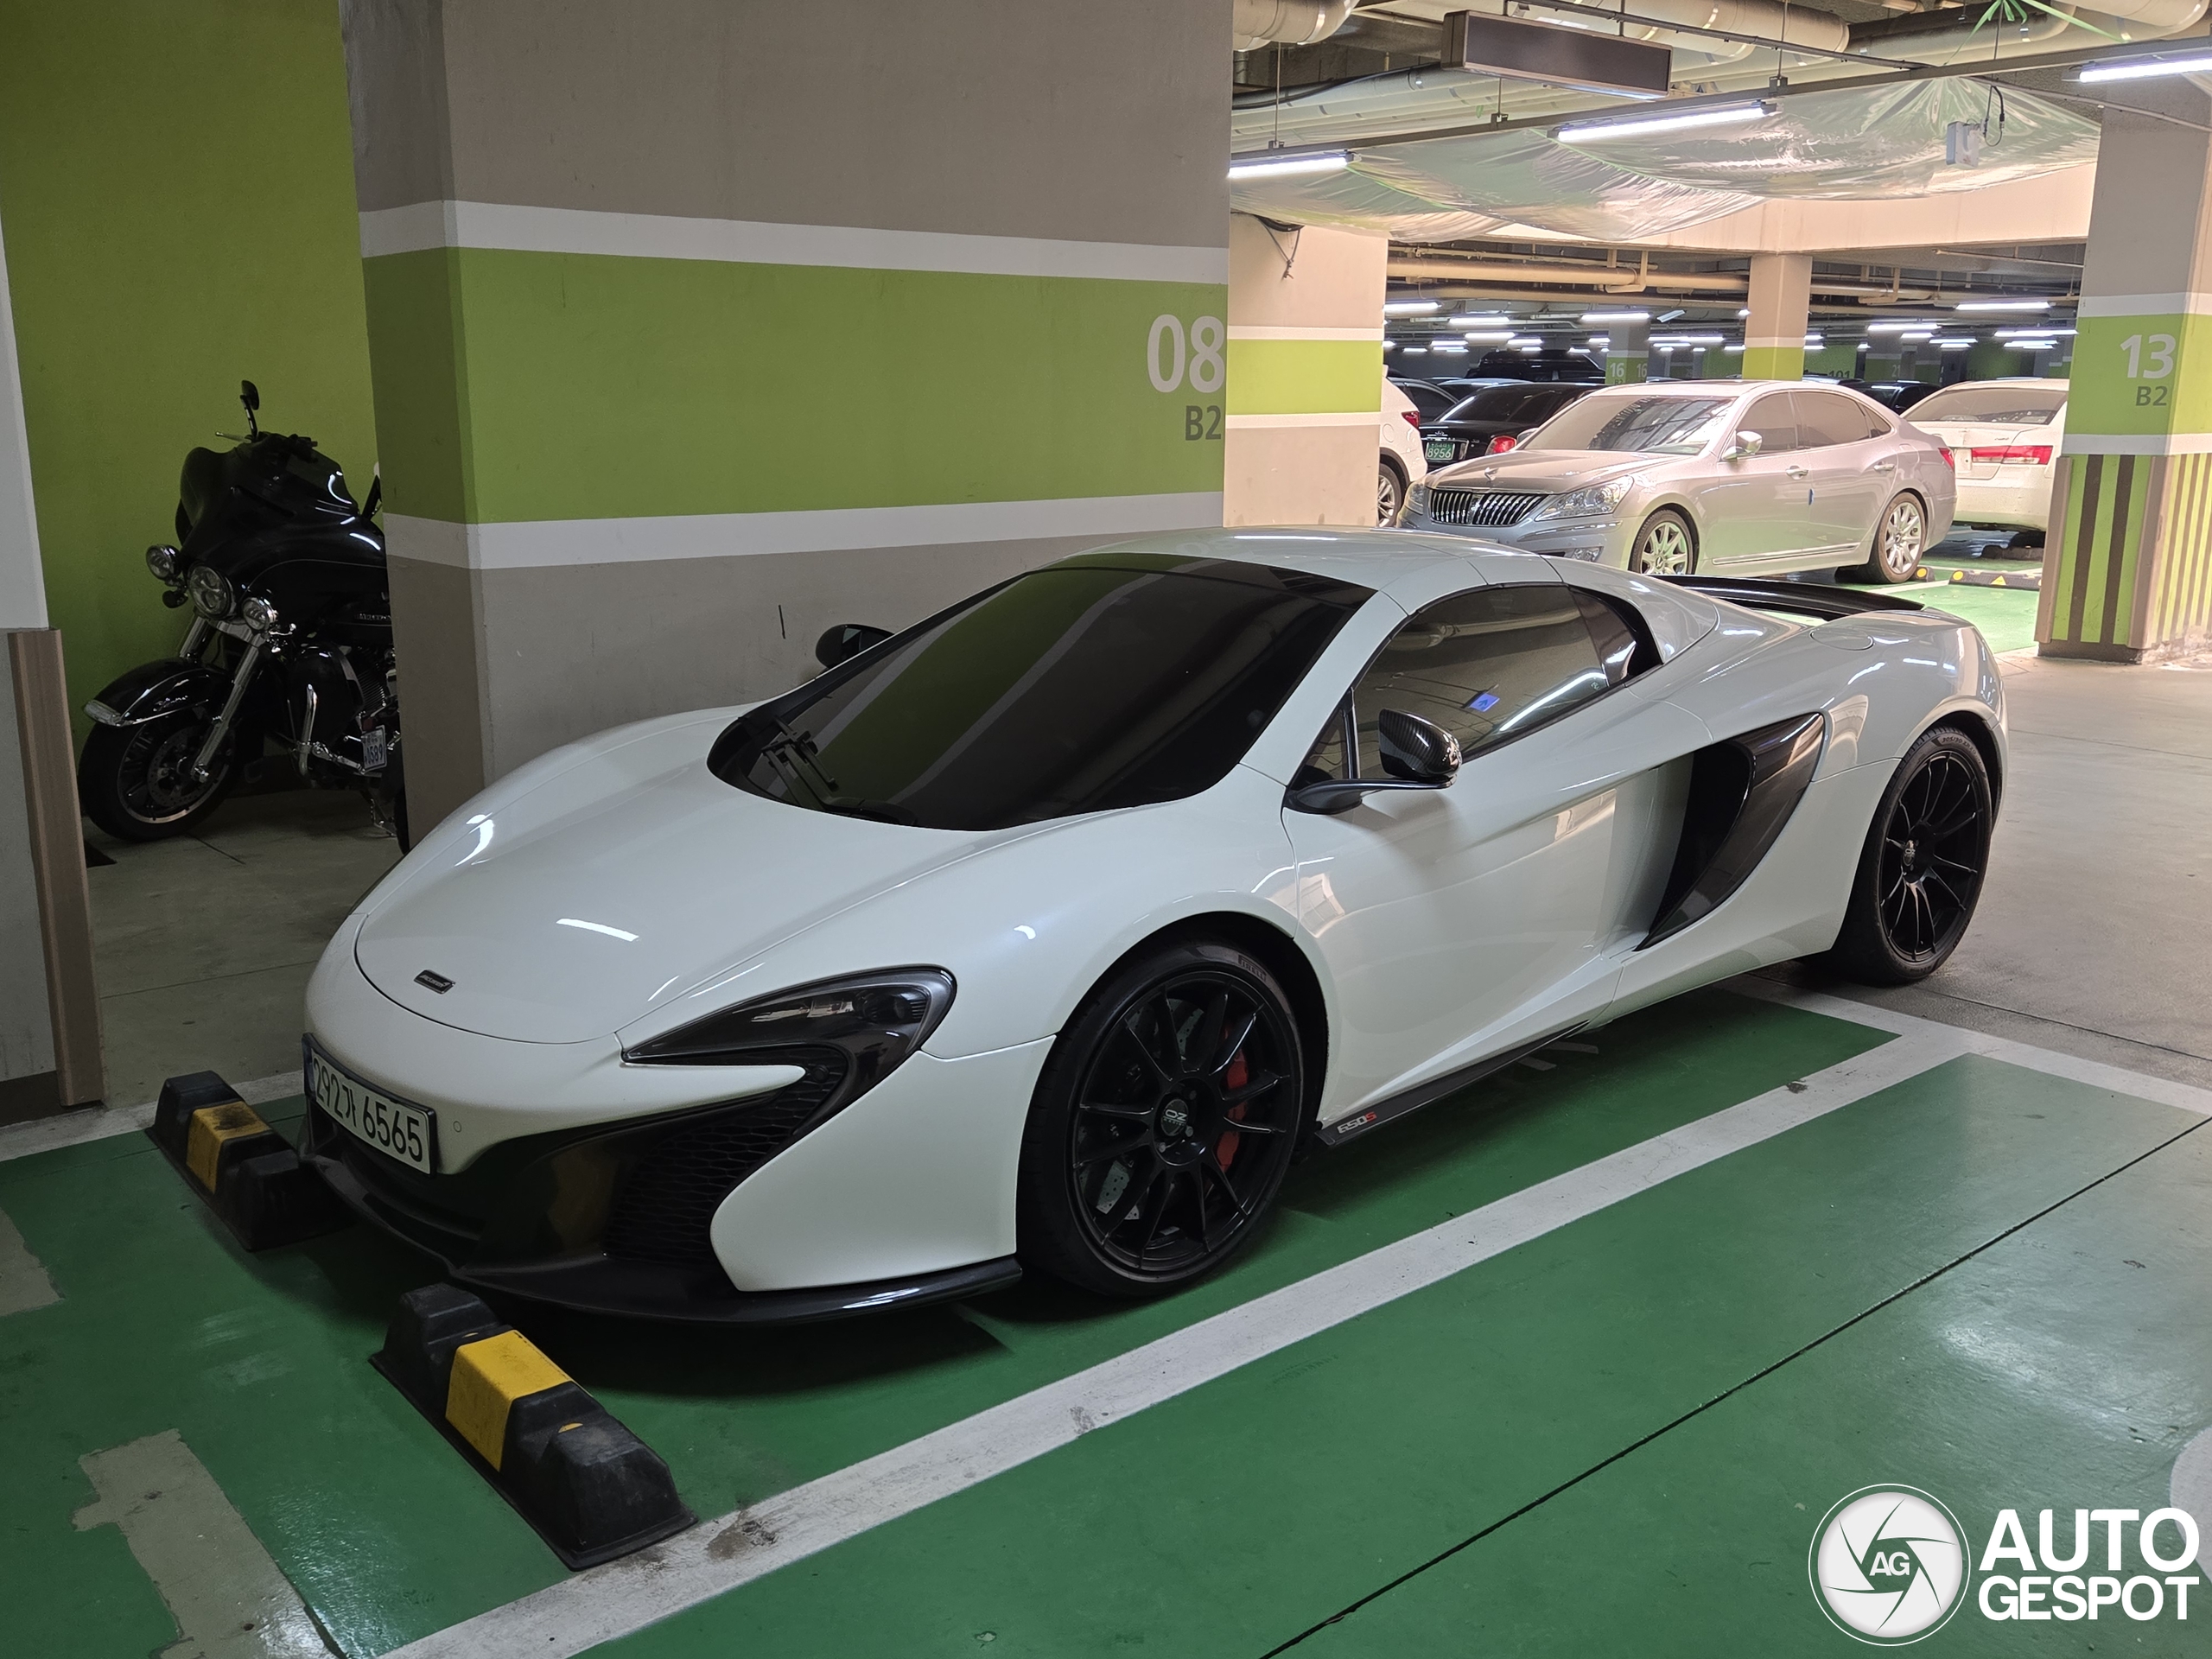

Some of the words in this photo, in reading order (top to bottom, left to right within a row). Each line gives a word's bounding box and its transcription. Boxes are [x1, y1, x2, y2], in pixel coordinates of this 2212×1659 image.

[1147, 314, 1225, 393] 08
[2120, 334, 2177, 379] 13
[1610, 362, 1624, 378] 16
[1637, 363, 1648, 378] 16
[2135, 385, 2168, 407] B2
[1185, 404, 1222, 442] B2
[1427, 448, 1452, 459] 8956
[313, 1057, 357, 1128] 292가
[362, 1096, 423, 1163] 6565
[1165, 1109, 1188, 1122] OZ
[1337, 1111, 1377, 1134] 650S
